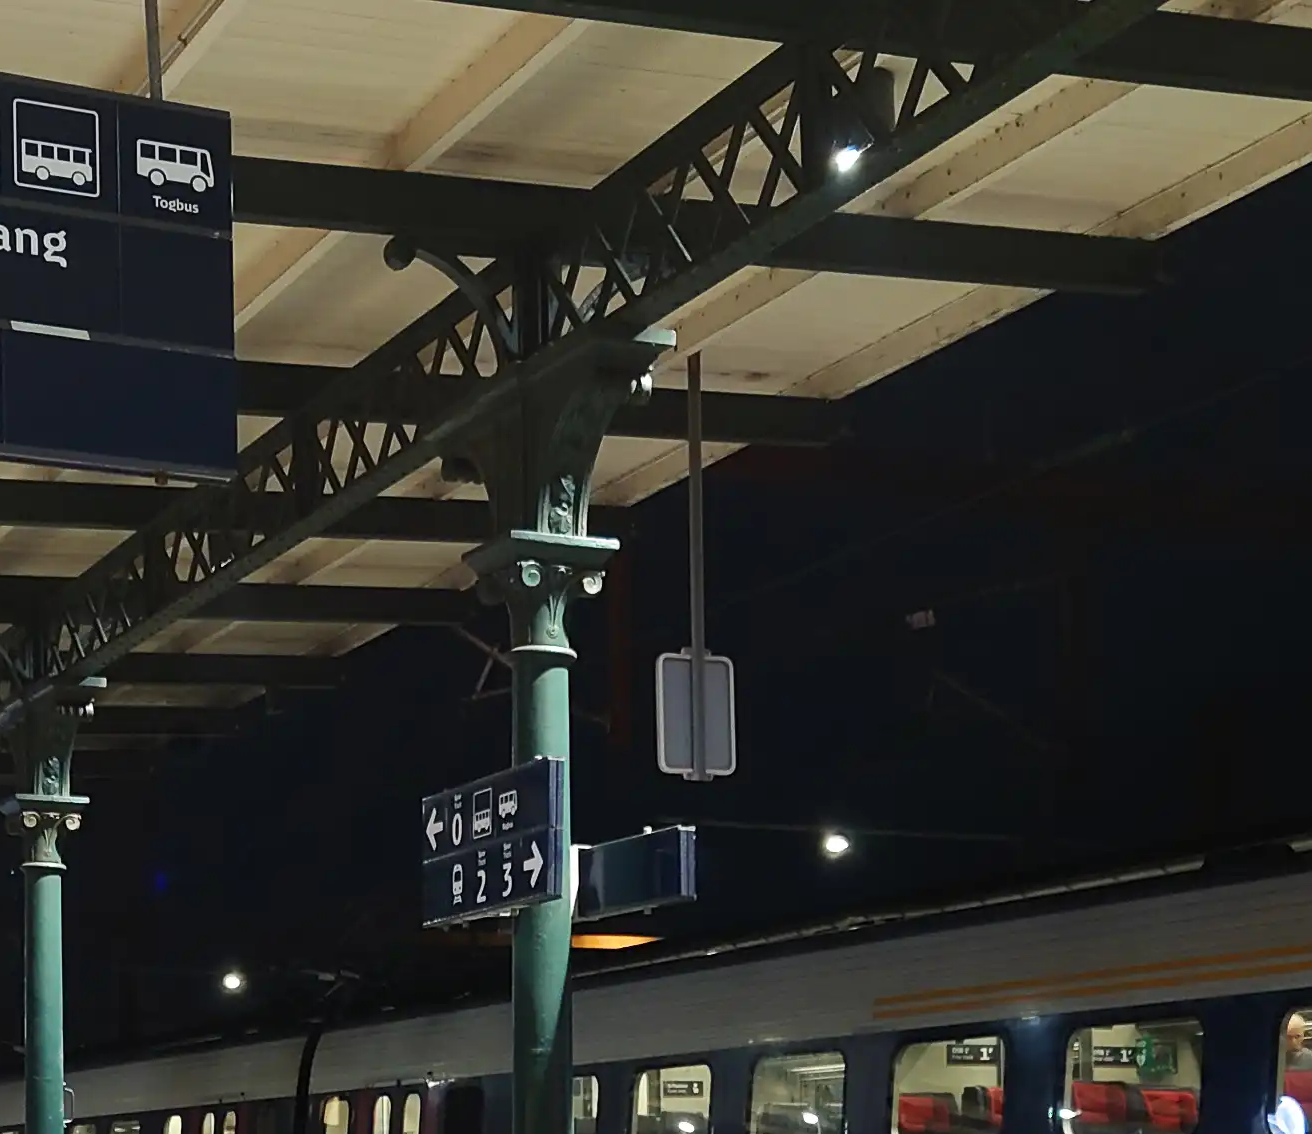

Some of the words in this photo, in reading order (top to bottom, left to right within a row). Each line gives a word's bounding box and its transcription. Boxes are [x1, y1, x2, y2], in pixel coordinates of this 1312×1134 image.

[152, 195, 199, 214] Togbus
[451, 812, 463, 846] 0
[476, 869, 487, 904] 2
[502, 862, 513, 898] 3
